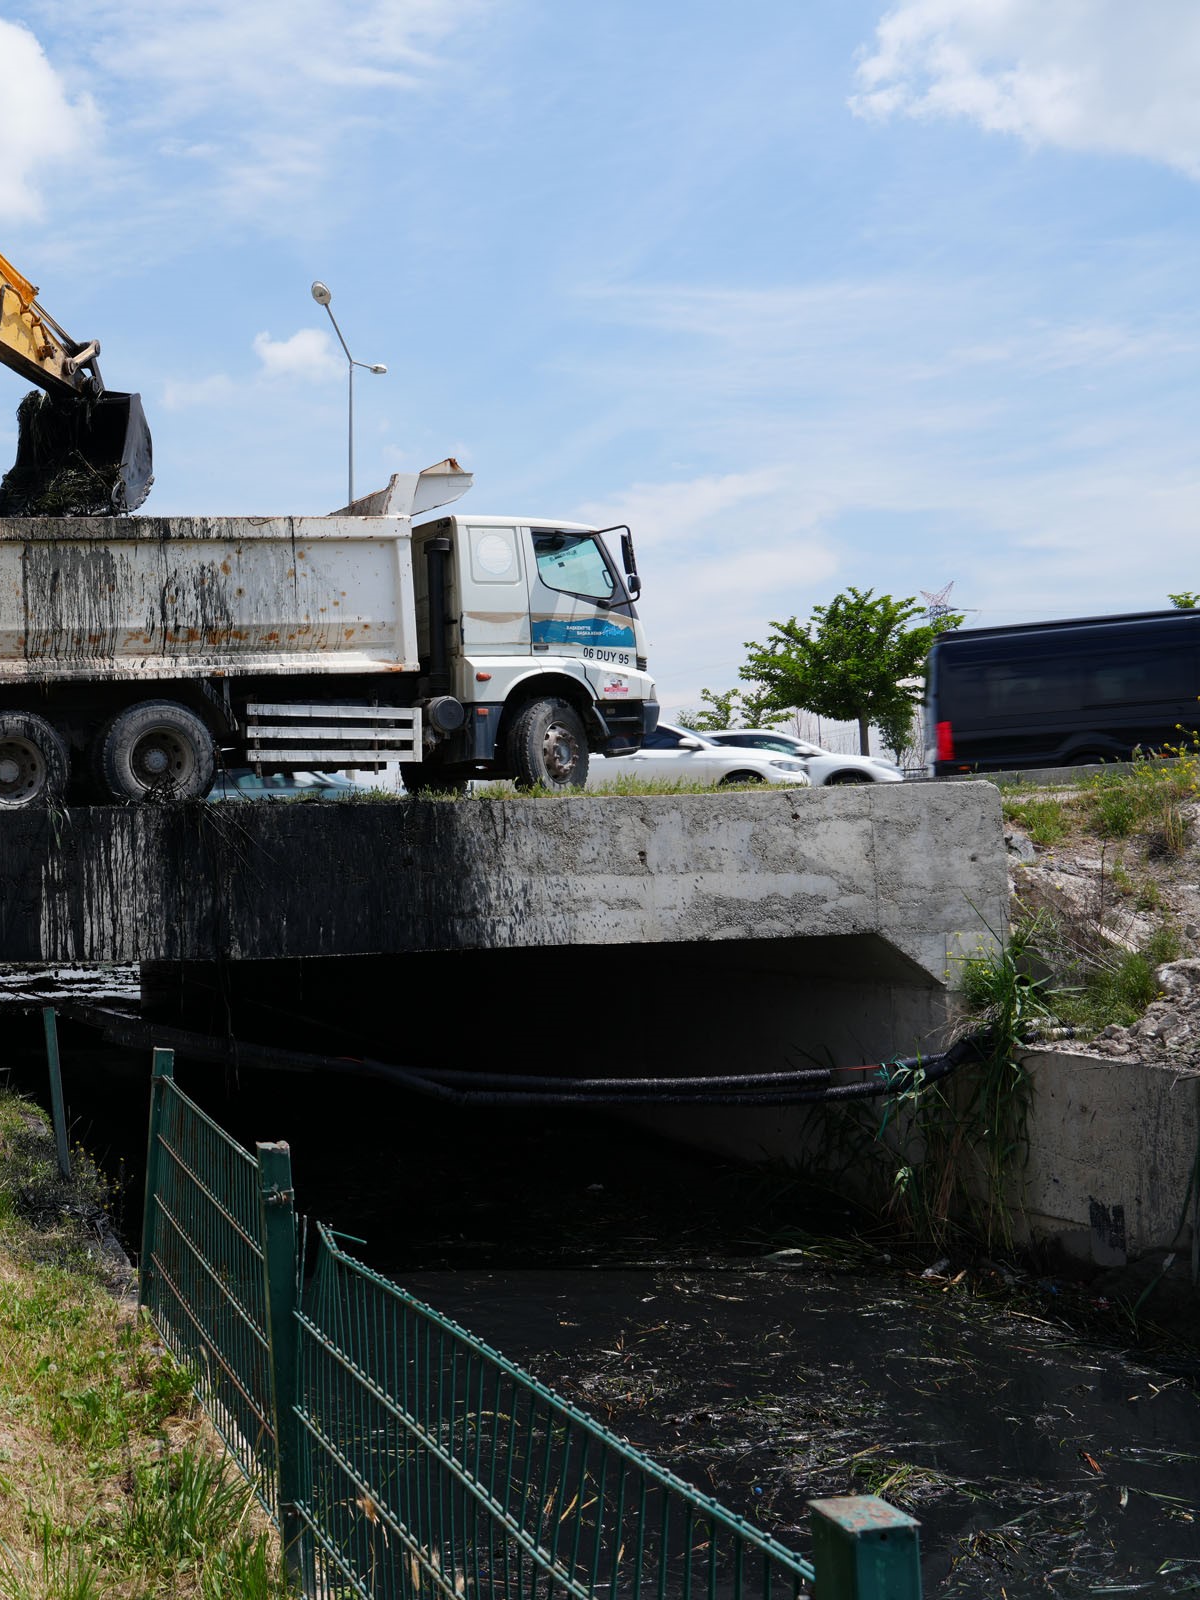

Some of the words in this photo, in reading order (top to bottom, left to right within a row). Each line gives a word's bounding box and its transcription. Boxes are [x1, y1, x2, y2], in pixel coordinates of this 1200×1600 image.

[583, 647, 594, 659] 06
[596, 649, 617, 662] DUY
[618, 653, 630, 665] 95
